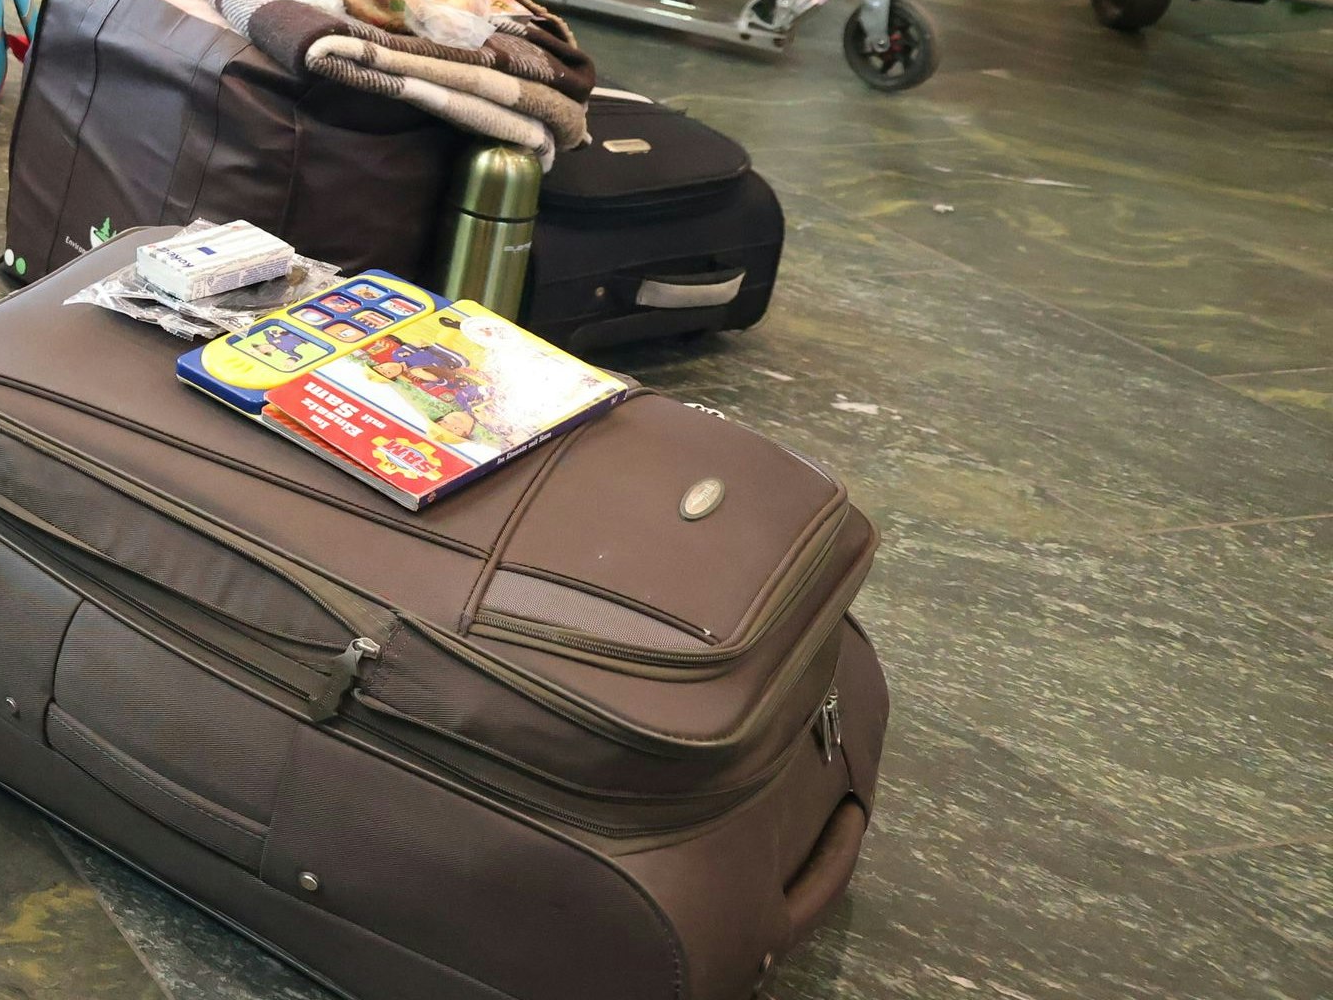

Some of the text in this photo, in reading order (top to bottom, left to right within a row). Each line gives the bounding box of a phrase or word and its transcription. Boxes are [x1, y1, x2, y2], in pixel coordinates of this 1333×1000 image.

[301, 397, 365, 438] Einsatz
[302, 381, 388, 430] mit Sam
[309, 414, 331, 431] Im
[384, 438, 437, 475] SAM
[538, 431, 553, 446] Sam
